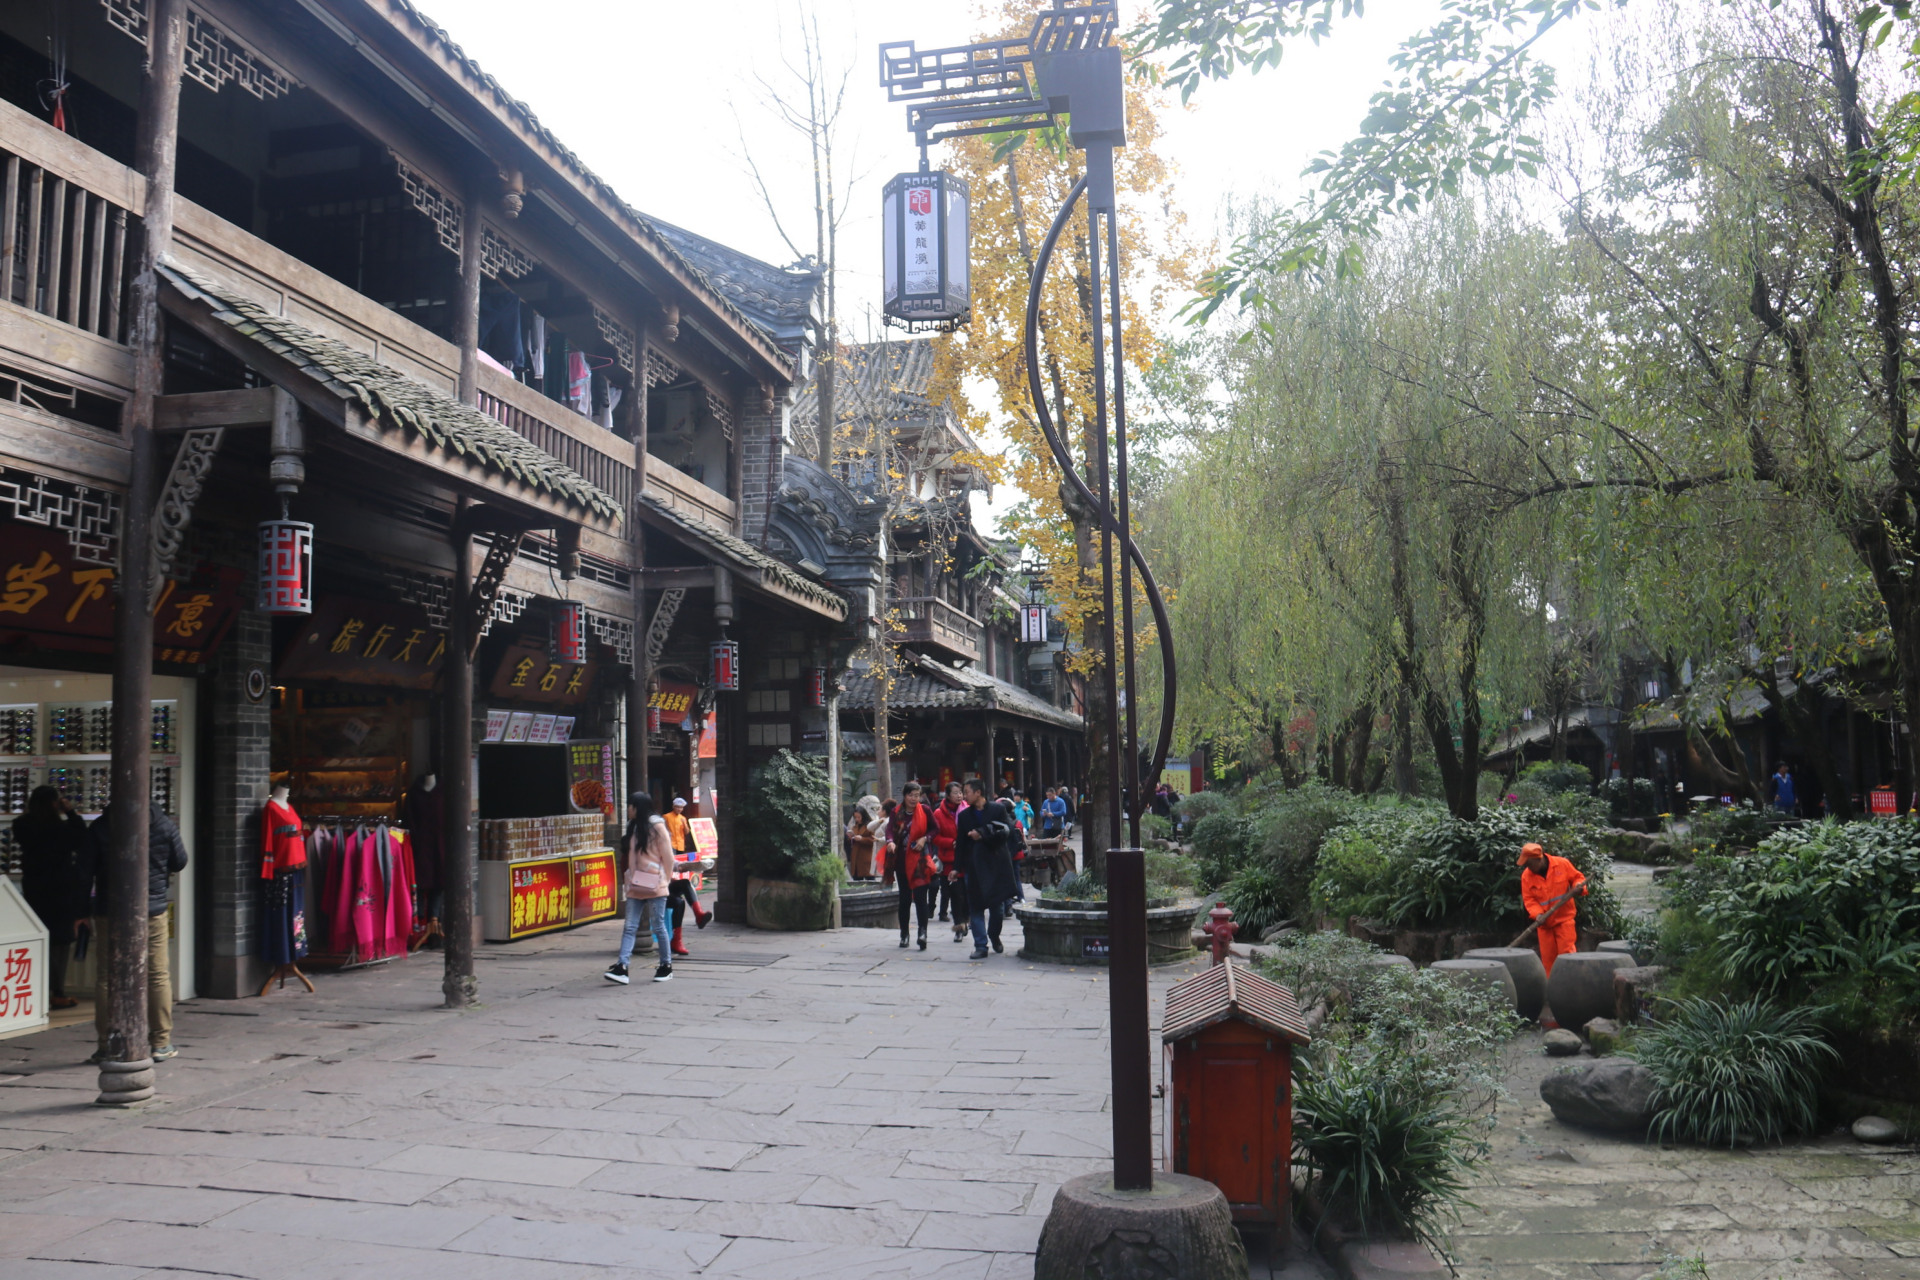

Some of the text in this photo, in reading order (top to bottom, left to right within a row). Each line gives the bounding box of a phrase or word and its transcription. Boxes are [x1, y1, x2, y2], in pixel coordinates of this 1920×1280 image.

[0, 551, 214, 638] 当下意
[511, 656, 585, 696] 金石头
[513, 885, 569, 929] 杂粮小麻花
[4, 948, 31, 984] 场
[0, 984, 33, 1017] 9元
